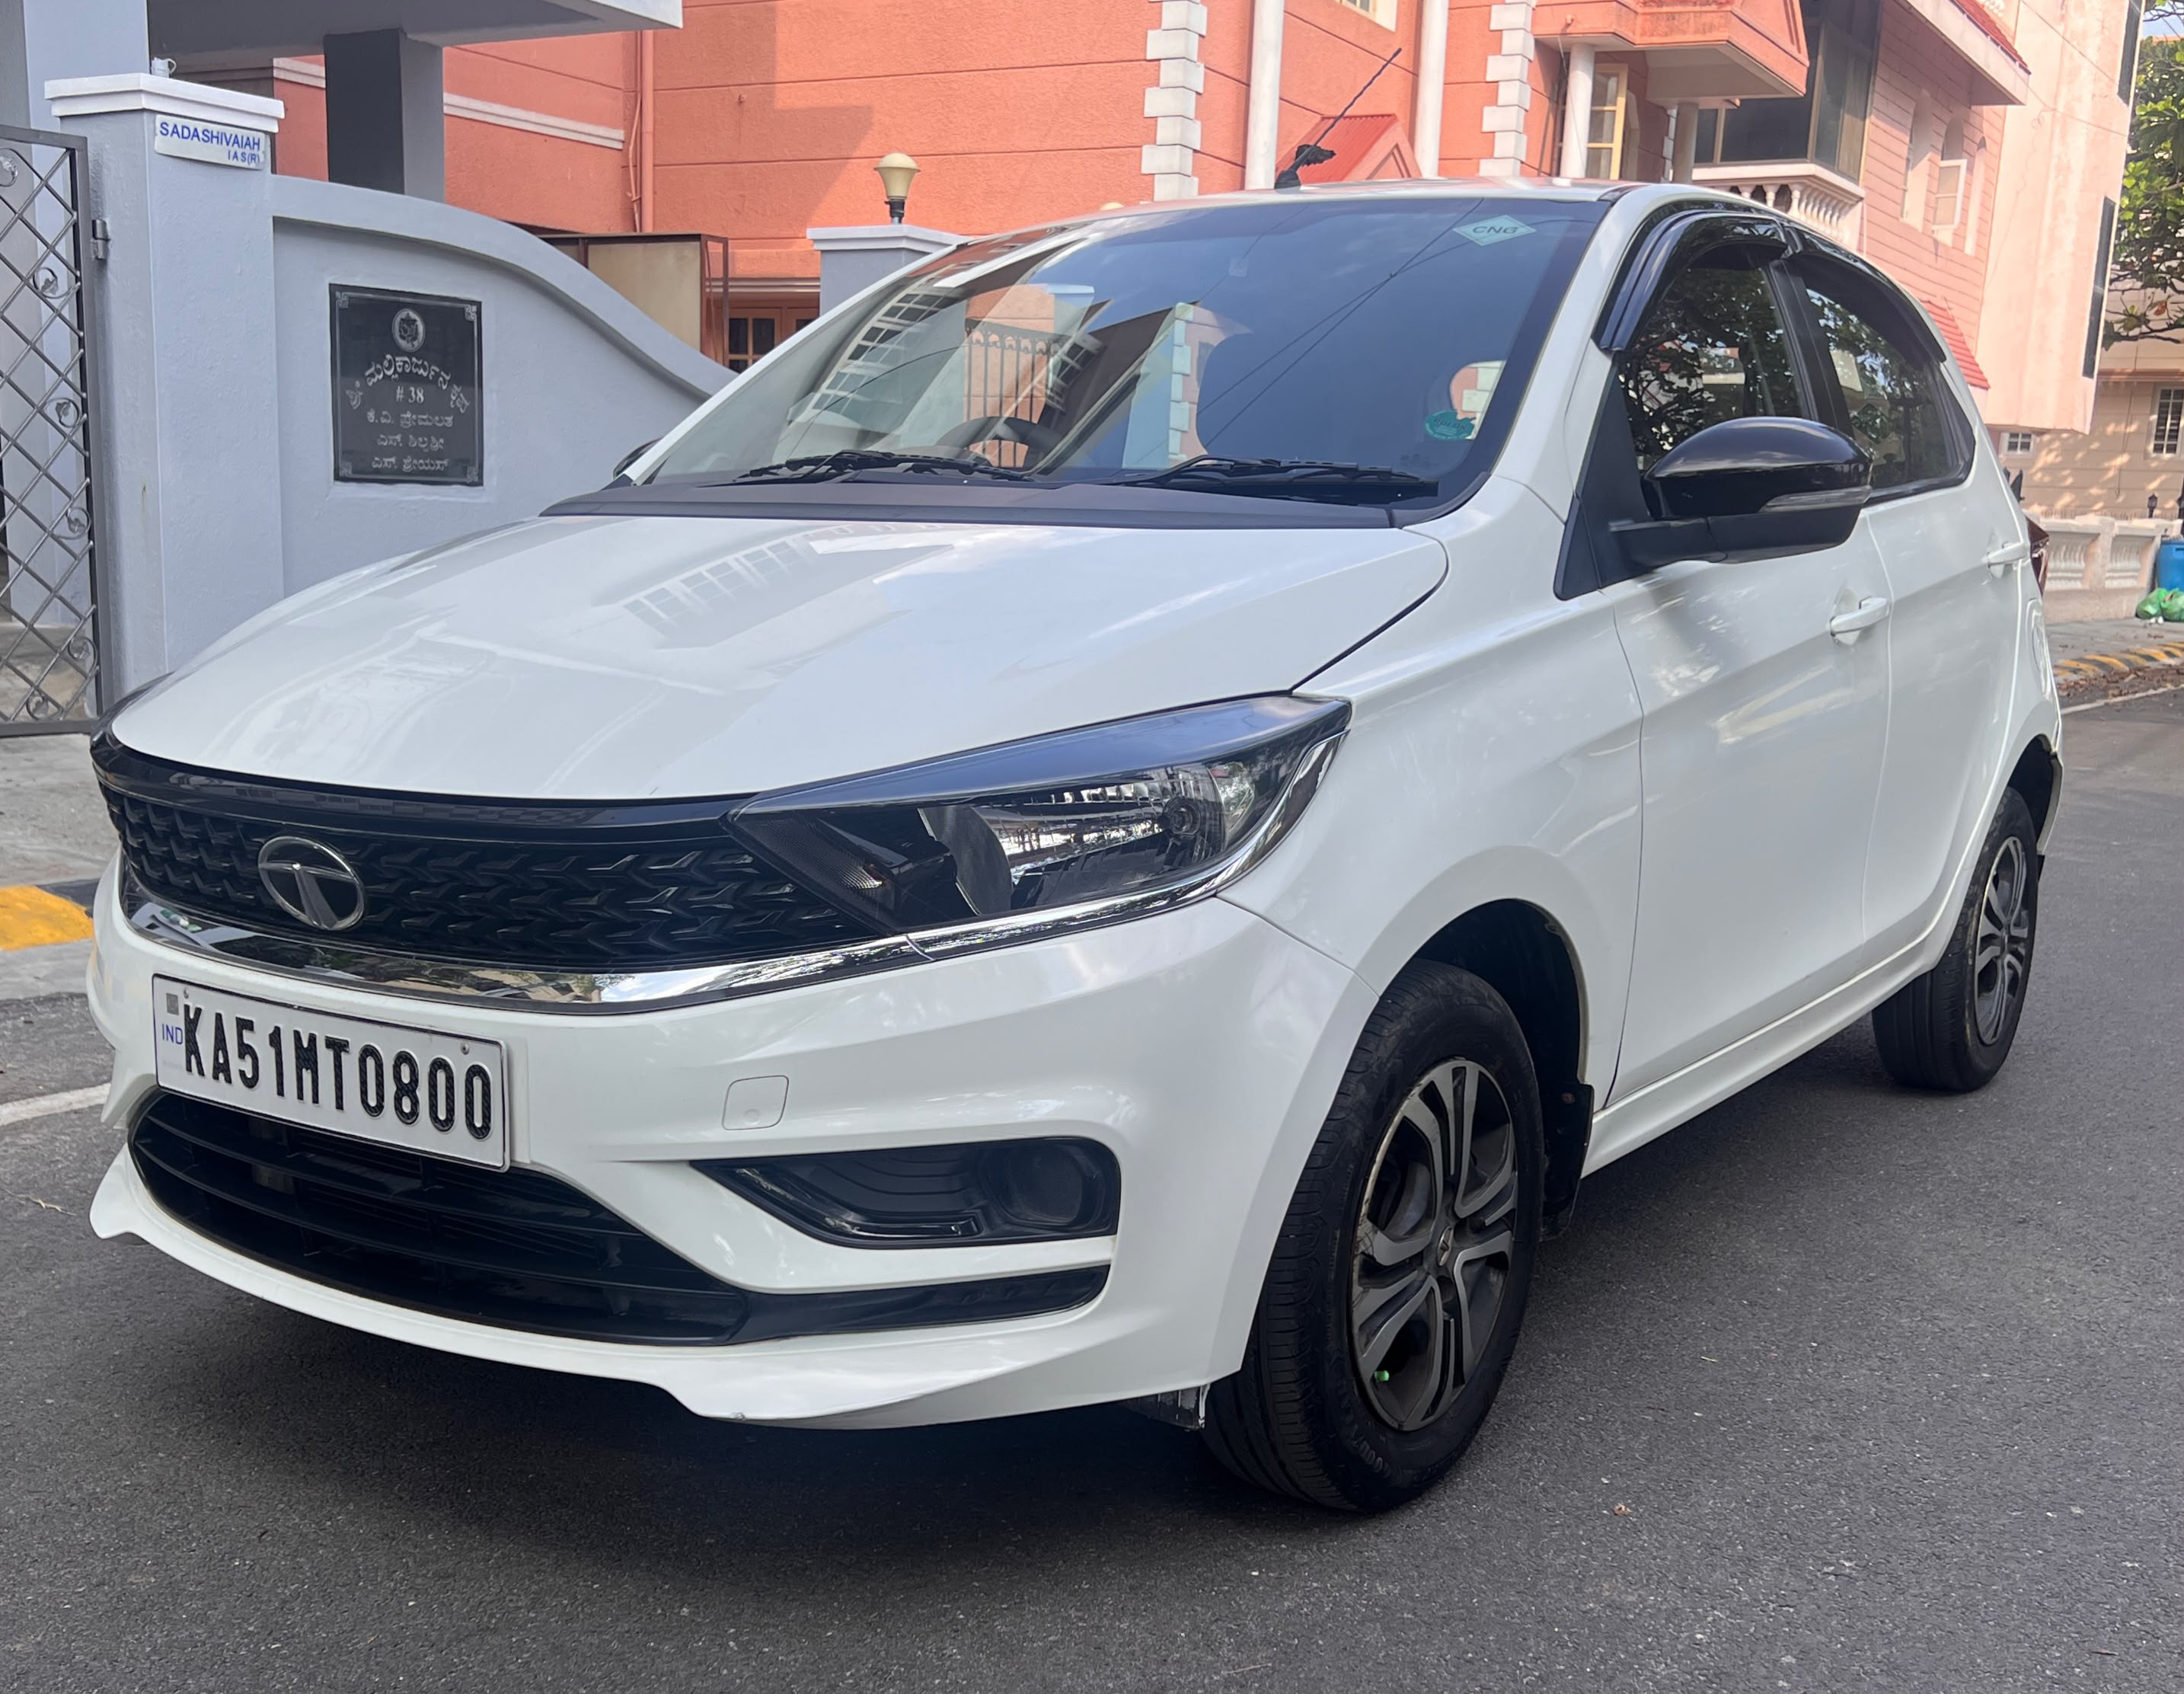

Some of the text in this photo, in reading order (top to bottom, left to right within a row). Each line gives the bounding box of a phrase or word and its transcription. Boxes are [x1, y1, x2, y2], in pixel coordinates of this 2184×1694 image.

[159, 122, 260, 151] SADASHIVAIAH
[1472, 225, 1518, 235] CNG
[408, 387, 424, 404] 38
[161, 1023, 184, 1045] IND
[184, 1003, 491, 1140] KA51MT0800
